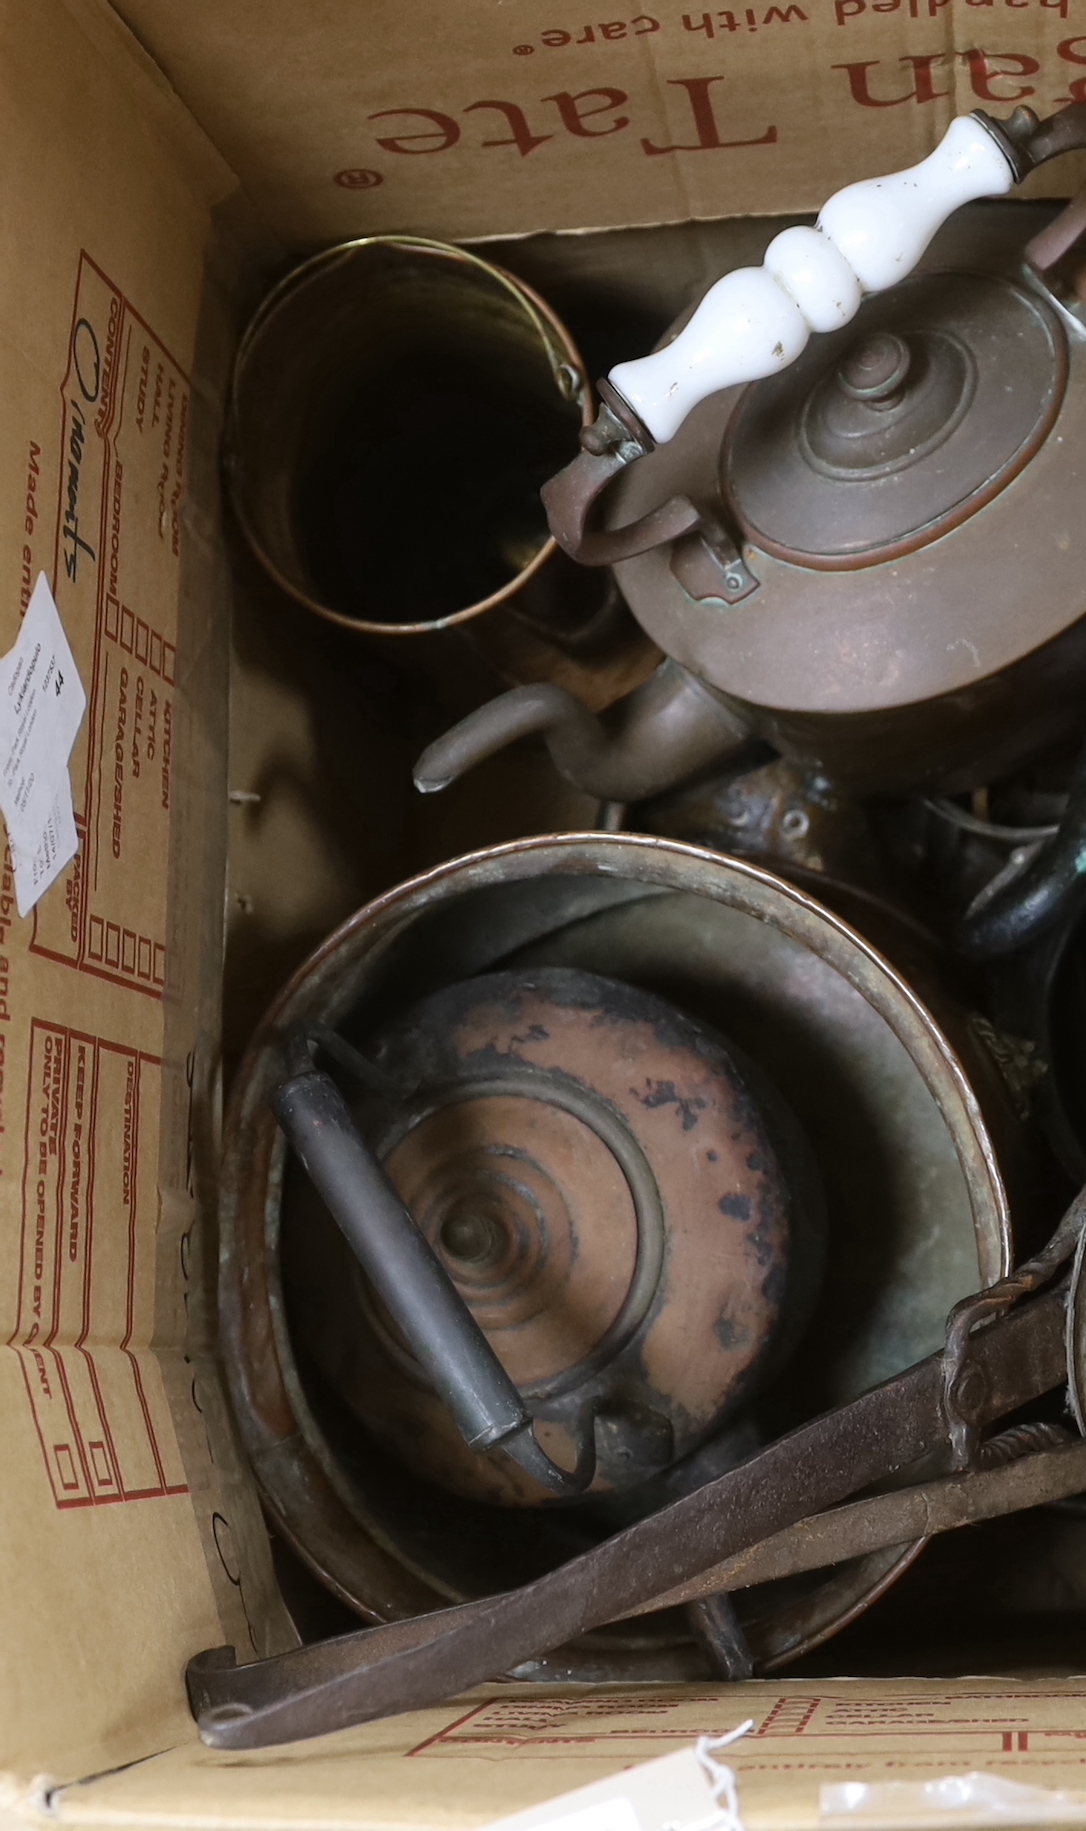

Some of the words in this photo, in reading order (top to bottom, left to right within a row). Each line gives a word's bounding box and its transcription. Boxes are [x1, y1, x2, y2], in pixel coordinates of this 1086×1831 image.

[682, 4, 810, 39] with
[135, 345, 151, 434] STUDY
[25, 440, 42, 537] Made
[107, 459, 124, 600] BEDROOM
[55, 669, 65, 697] 44
[132, 675, 147, 779] CELLAR
[146, 688, 158, 762] ATTIC
[112, 666, 130, 860] GARAGE/SHED
[161, 699, 173, 810] KITCHEN
[69, 853, 82, 943] PACKED
[42, 1034, 54, 1100] ONLY
[48, 1036, 63, 1156] PRIVATE
[74, 1044, 87, 1120] KEEP
[38, 1140, 48, 1175] BE
[39, 1102, 50, 1138] TO
[122, 1059, 134, 1206] DESTINATION
[34, 1179, 46, 1282] OPENED
[69, 1122, 83, 1263] FORWARD
[32, 1284, 42, 1319] BY
